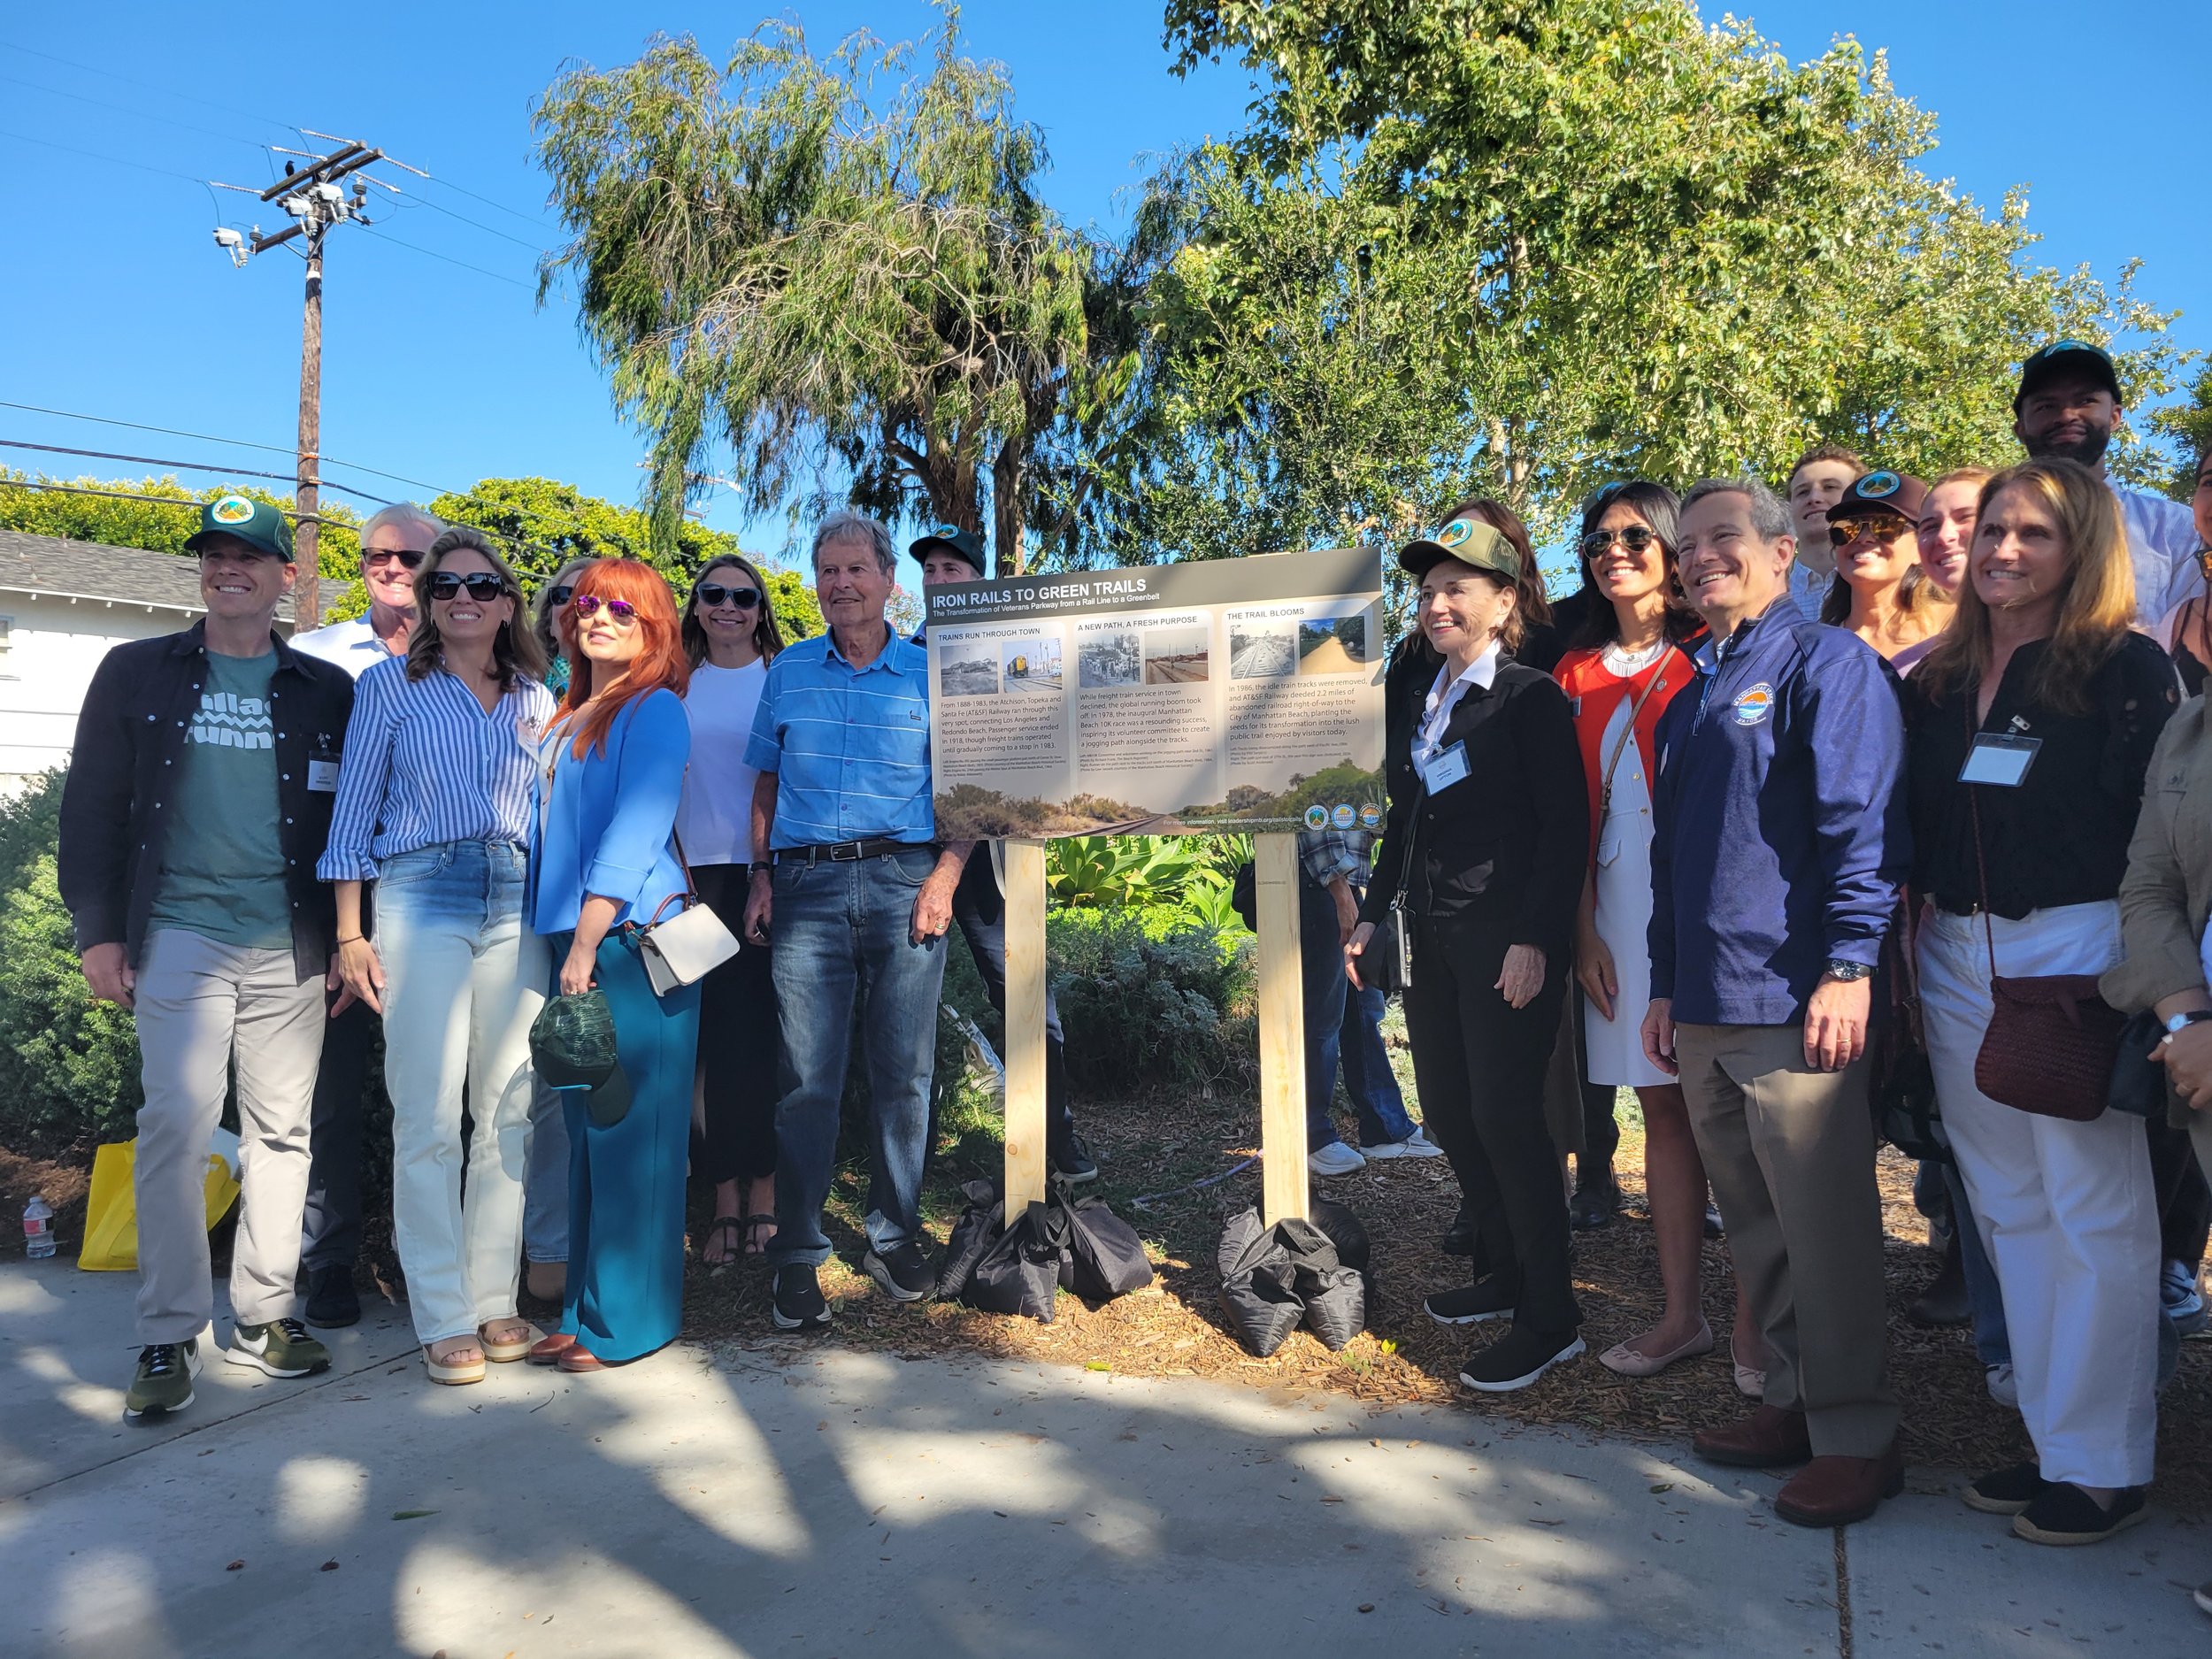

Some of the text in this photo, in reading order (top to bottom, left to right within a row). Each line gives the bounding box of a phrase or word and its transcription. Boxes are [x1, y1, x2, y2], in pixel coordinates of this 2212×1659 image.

[933, 579, 1146, 607] IRON RAILS TO GREEN TRAILS
[1126, 593, 1159, 601] Greenbelt
[1270, 608, 1304, 616] BLOOMS
[1160, 616, 1196, 624] PURPOSE
[201, 692, 271, 715] illa
[1119, 700, 1139, 709] global
[1229, 703, 1266, 711] abandoned
[1293, 700, 1334, 708] right-of-way
[1127, 709, 1156, 717] inaugural
[184, 726, 275, 749] runn
